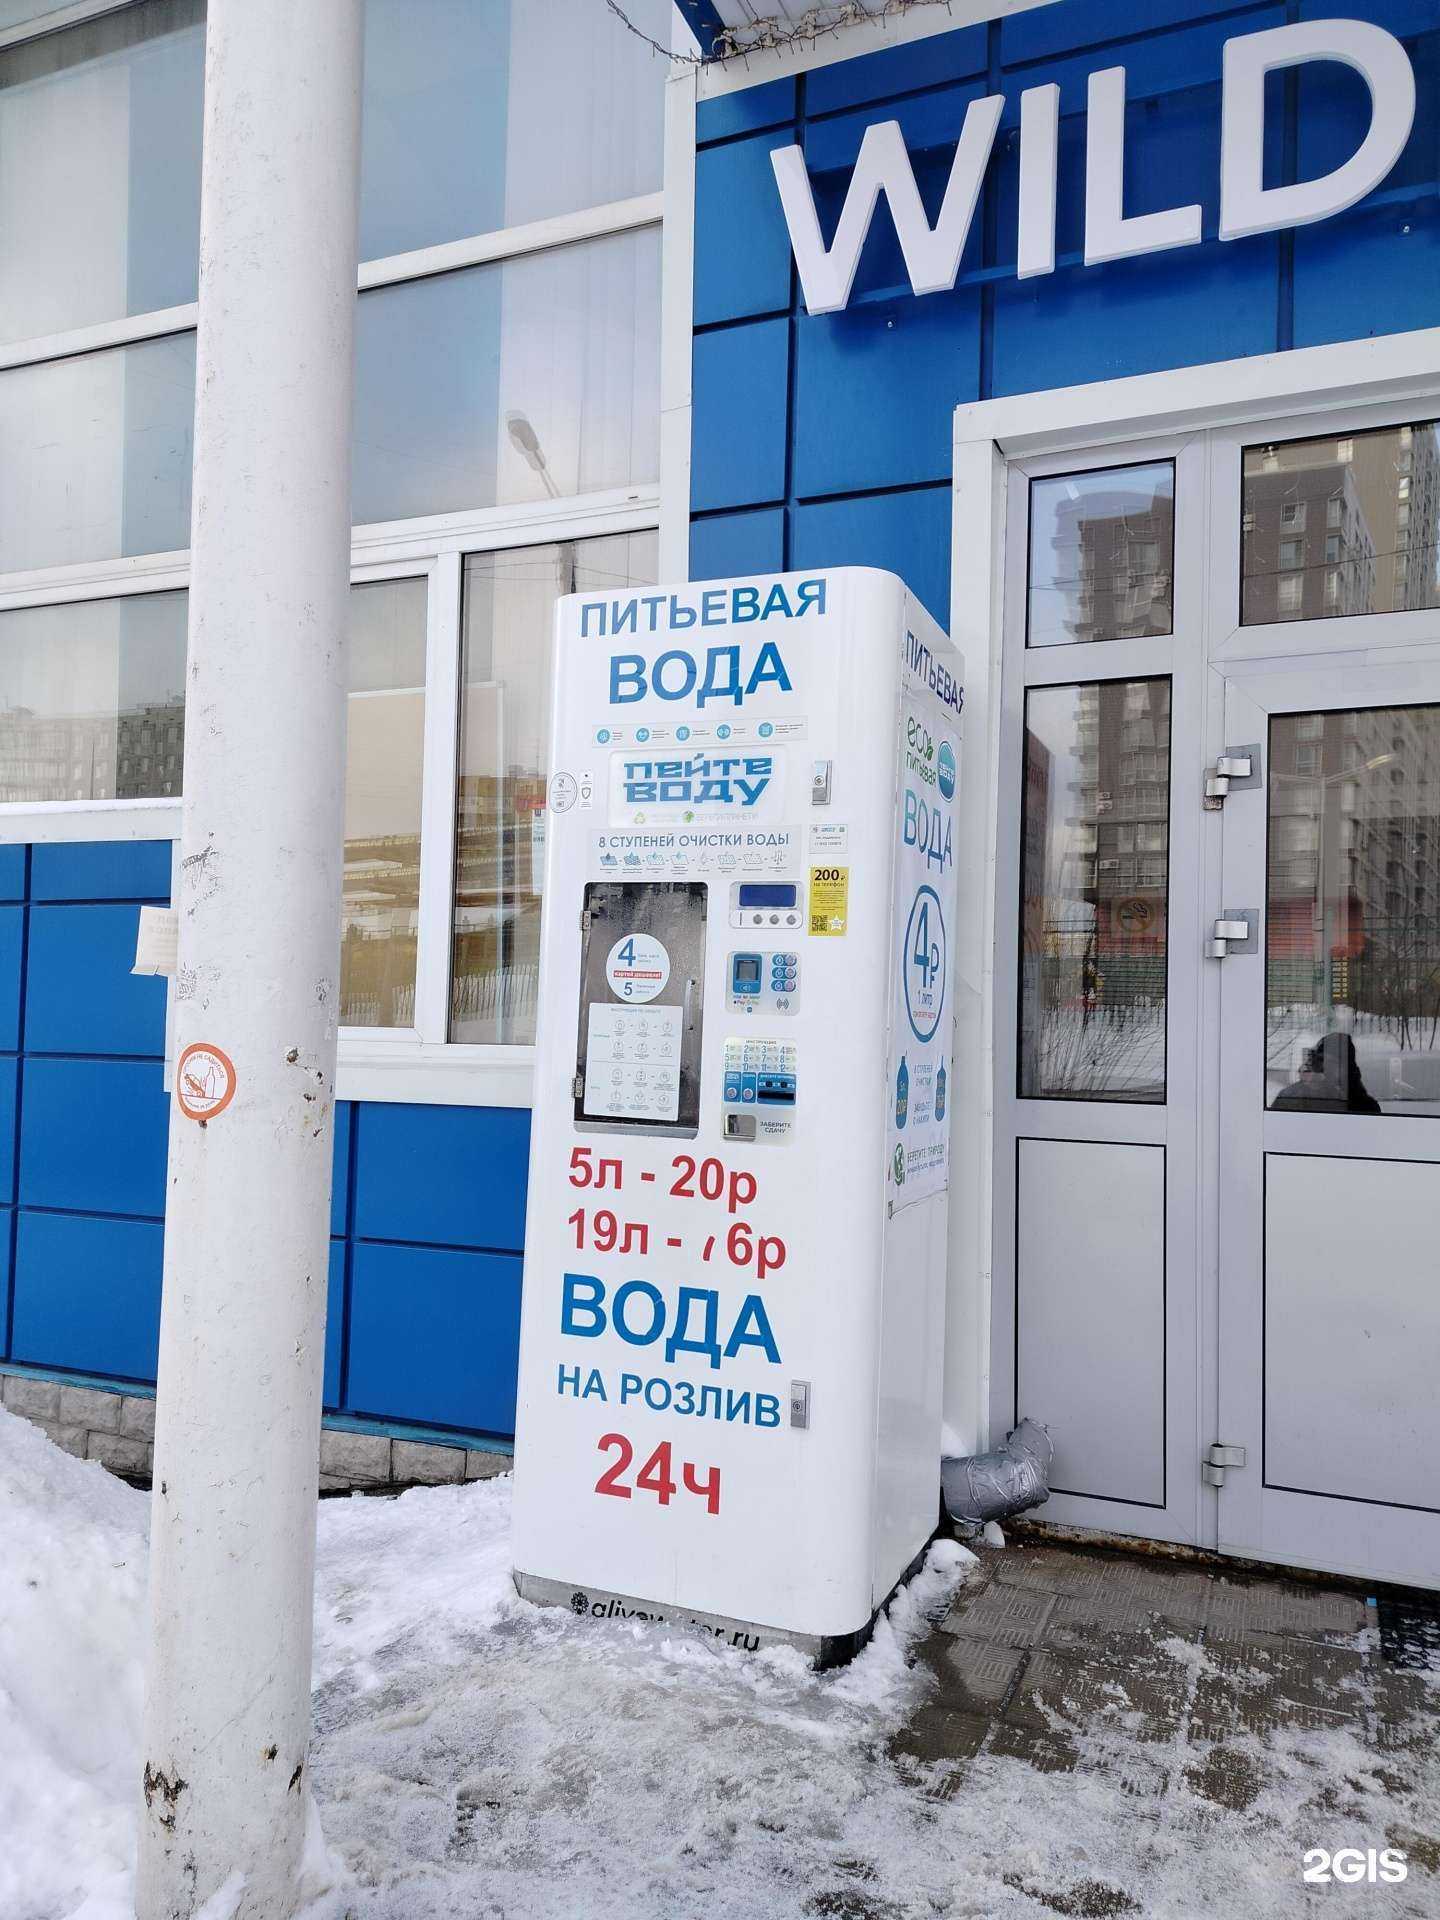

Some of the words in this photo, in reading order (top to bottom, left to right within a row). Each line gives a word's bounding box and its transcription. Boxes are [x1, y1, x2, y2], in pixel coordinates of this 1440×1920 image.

[770, 18, 1416, 317] WILD
[581, 578, 827, 637] ПИТЬЕВАЯ
[609, 641, 793, 709] ВОДА
[624, 778, 770, 806] ВОДУ
[599, 838, 606, 848] 8
[609, 833, 675, 848] СТУПЕНЕЙ
[679, 834, 742, 847] ОЧИСТКИ
[747, 833, 790, 847] ВОДЫ
[903, 788, 953, 874] ВОДА
[814, 869, 840, 881] 200
[618, 938, 636, 966] 4
[624, 982, 633, 996] 5
[568, 1147, 623, 1190] 5л
[669, 1155, 758, 1213] 20р
[567, 1208, 648, 1254] 19л
[561, 1273, 782, 1370] ВОДА
[557, 1364, 608, 1402] НА
[620, 1373, 781, 1429] РОЗЛИВ
[595, 1433, 721, 1515] 24ч
